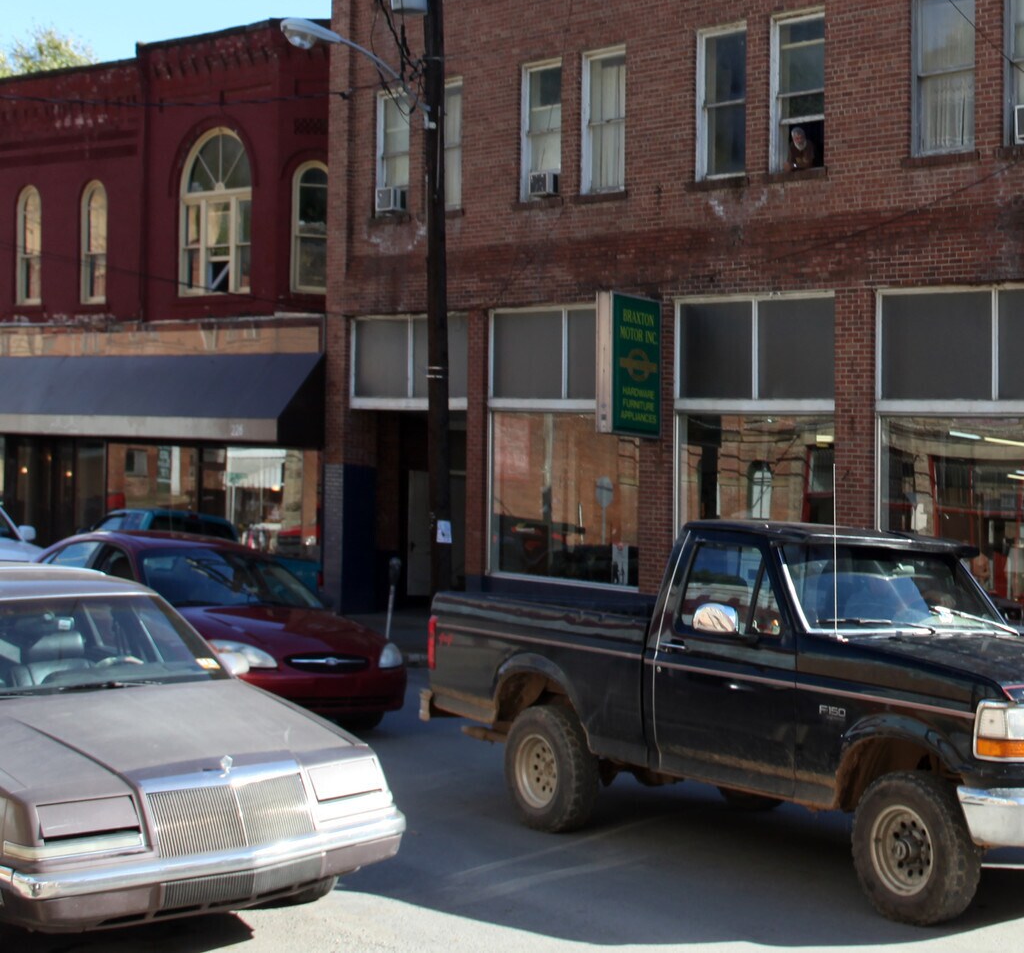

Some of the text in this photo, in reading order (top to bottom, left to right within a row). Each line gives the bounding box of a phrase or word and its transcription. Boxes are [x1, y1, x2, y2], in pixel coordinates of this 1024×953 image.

[622, 308, 655, 326] BRAXTON
[620, 326, 643, 342] MOTOR
[622, 386, 655, 399] HARDWARE
[622, 398, 654, 411] FURNITURE
[620, 410, 657, 424] APPLIANCES
